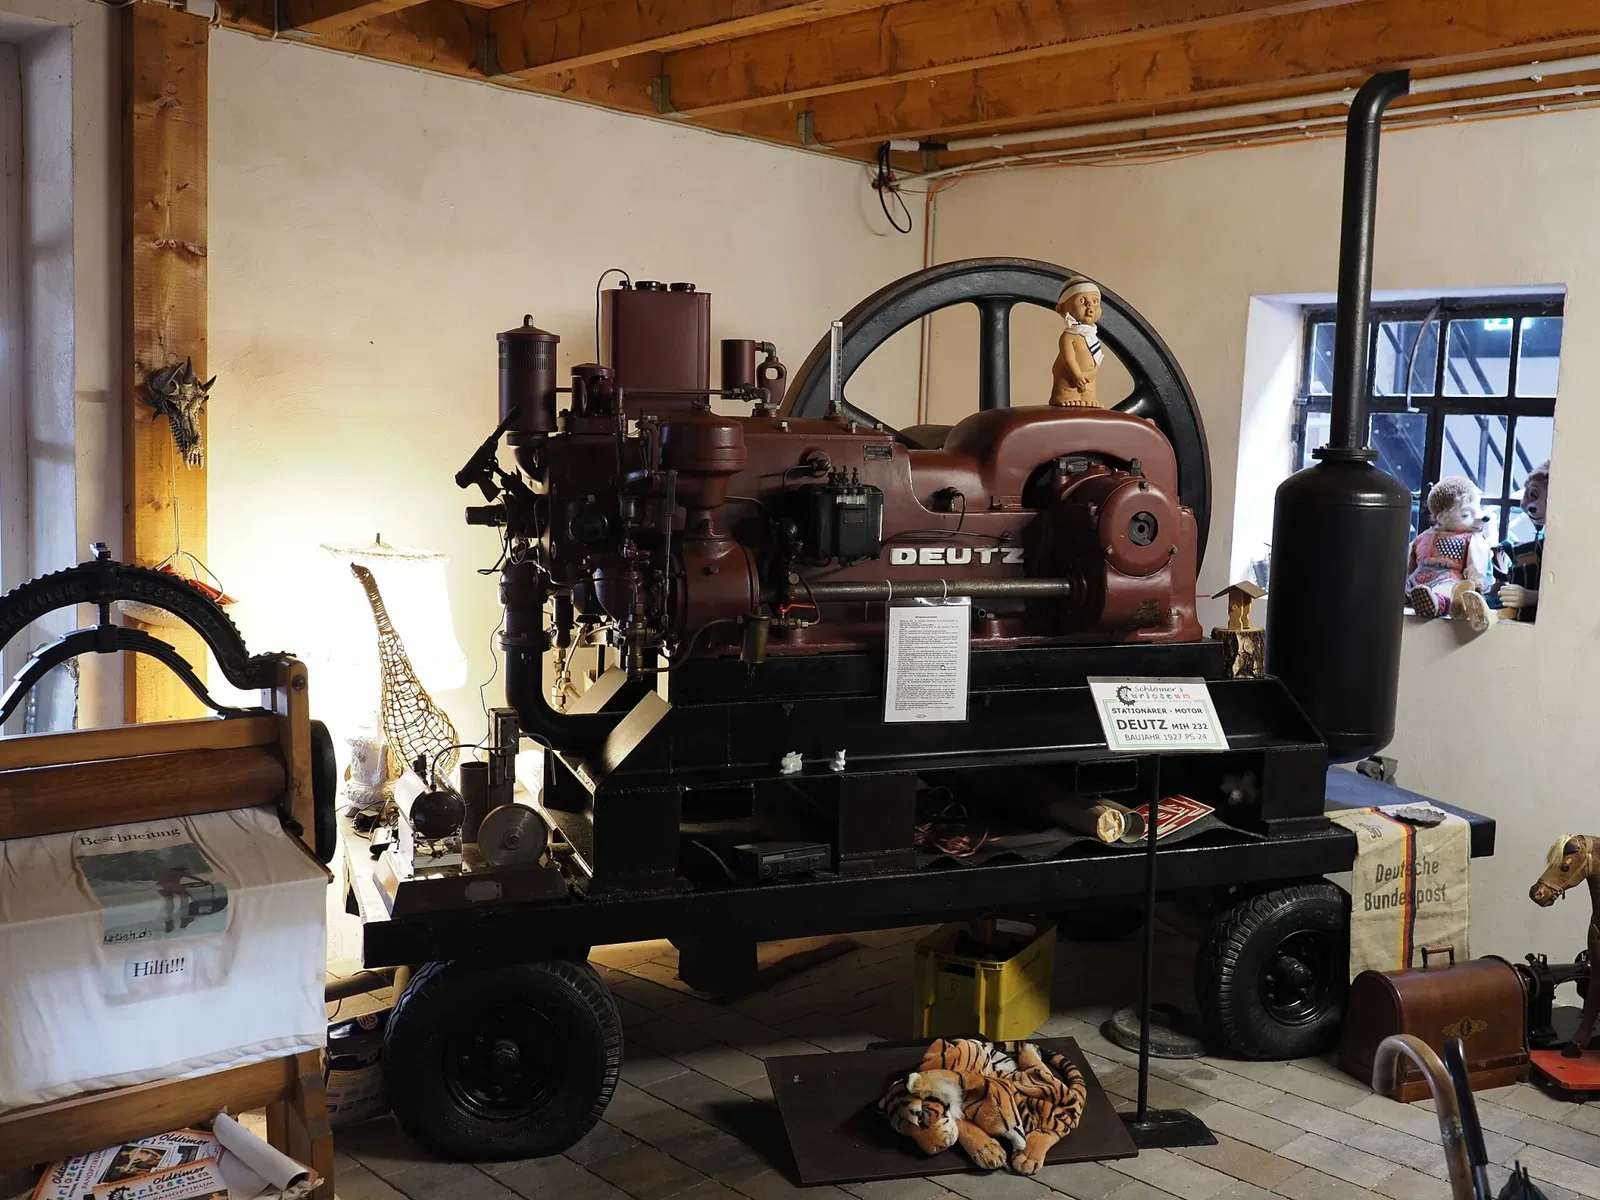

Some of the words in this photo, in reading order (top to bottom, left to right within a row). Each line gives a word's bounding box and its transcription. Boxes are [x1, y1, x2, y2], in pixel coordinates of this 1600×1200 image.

[890, 547, 1025, 566] DEUTZ
[1116, 719, 1168, 730] DEUTZ
[1163, 733, 1182, 741] 1927
[133, 957, 185, 977] Hilft!!!
